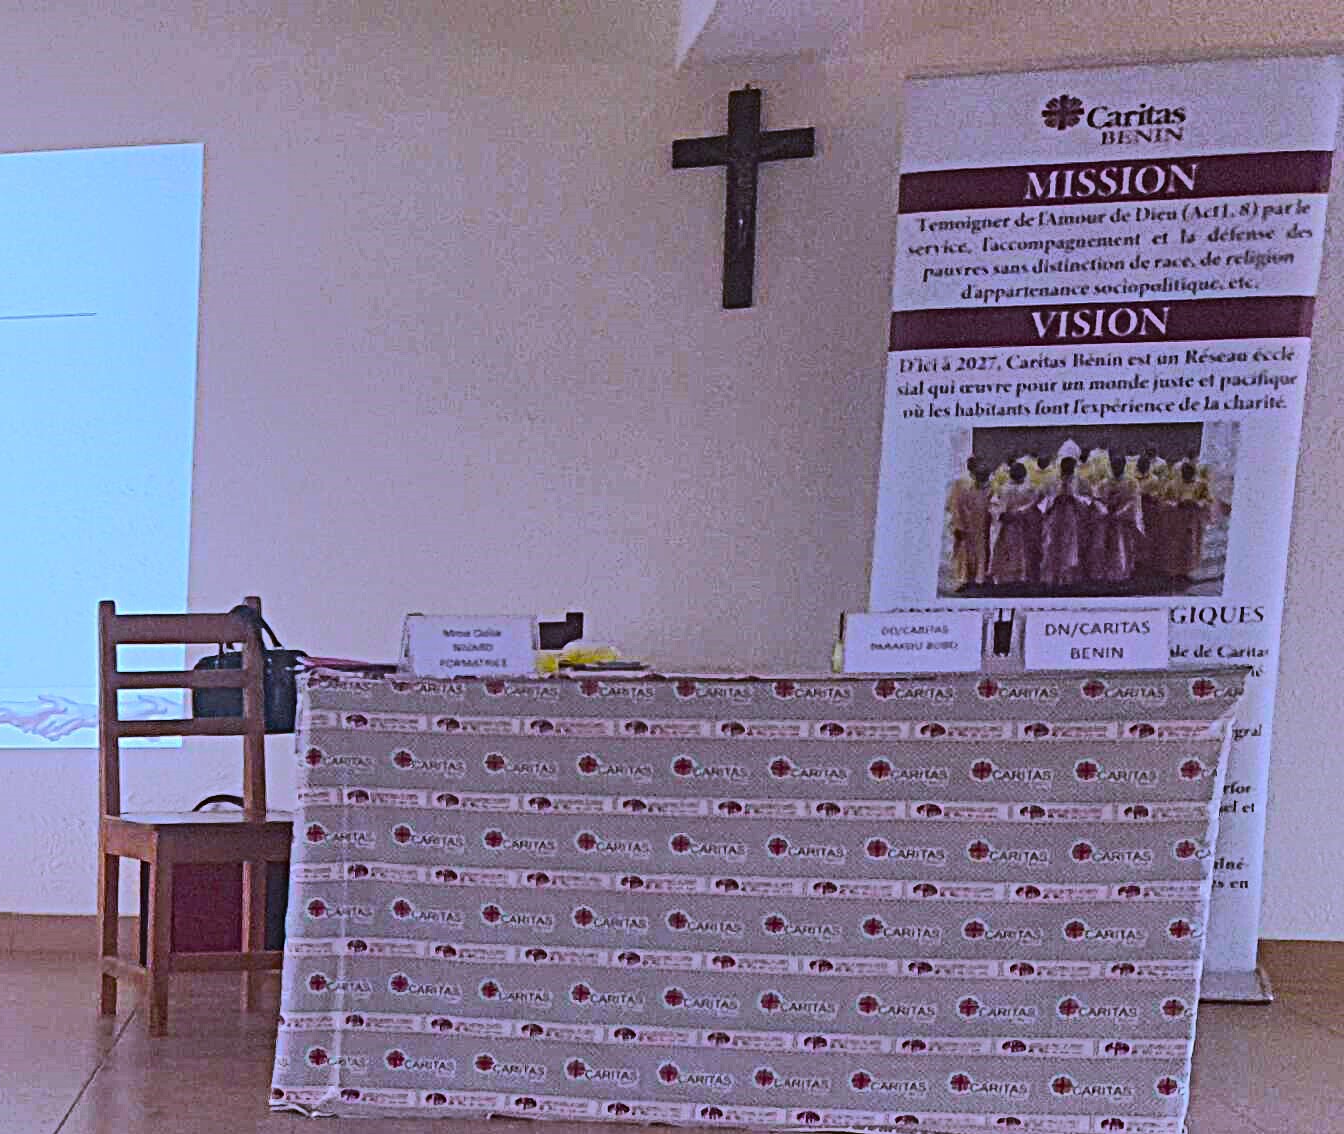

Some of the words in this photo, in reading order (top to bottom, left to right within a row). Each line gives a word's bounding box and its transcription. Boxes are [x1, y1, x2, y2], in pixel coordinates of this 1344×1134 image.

[1087, 102, 1187, 129] Caritas
[1100, 126, 1184, 145] BENIN
[1024, 163, 1199, 201] MISSION
[1014, 212, 1035, 227] de
[1109, 207, 1131, 223] de
[1135, 206, 1178, 222] Dieu
[1263, 204, 1294, 222] par
[1295, 200, 1311, 214] le
[982, 234, 1140, 254] l'accompagnement
[1151, 232, 1169, 245] et
[1180, 229, 1196, 244] la
[1208, 226, 1275, 243] défense
[1286, 223, 1313, 239] des
[923, 264, 989, 282] pauvres
[992, 263, 1029, 275] sans
[1031, 257, 1125, 275] distinction
[1129, 255, 1151, 270] de
[1199, 251, 1222, 267] de
[1225, 249, 1295, 271] religion
[960, 284, 1090, 304] d'appartenance
[1031, 307, 1171, 340] VISION
[941, 354, 952, 372] à
[1006, 351, 1067, 369] Caritas
[1072, 351, 1123, 368] Bénin
[1127, 351, 1151, 367] est
[1157, 352, 1179, 366] un
[1185, 347, 1248, 365] Réseau
[897, 380, 925, 397] sial
[927, 379, 957, 400] qui
[1015, 380, 1059, 398] pour
[1062, 379, 1085, 393] un
[1088, 373, 1150, 392] monde
[1153, 374, 1195, 392] juste
[1197, 373, 1215, 388] et
[1218, 371, 1299, 392] pacifique
[928, 401, 952, 418] les
[955, 401, 1032, 418] habitants
[1034, 399, 1070, 416] font
[1072, 399, 1177, 419] l'expérience
[1178, 396, 1202, 413] de
[1204, 395, 1220, 412] la
[1169, 605, 1265, 628] GIQUES
[1045, 620, 1151, 639] DN/CARITAS
[1070, 646, 1124, 660] BENIN
[1193, 643, 1212, 658] de
[795, 687, 851, 699] CARITAS
[895, 687, 953, 699] CARITAS
[999, 687, 1058, 699] CARITAS
[1104, 687, 1165, 699] CARITAS
[992, 770, 1052, 781] CARITAS
[1241, 802, 1255, 813] et
[1229, 880, 1249, 889] en
[594, 918, 646, 929] CARITAS
[1078, 1007, 1137, 1017] CARITAS
